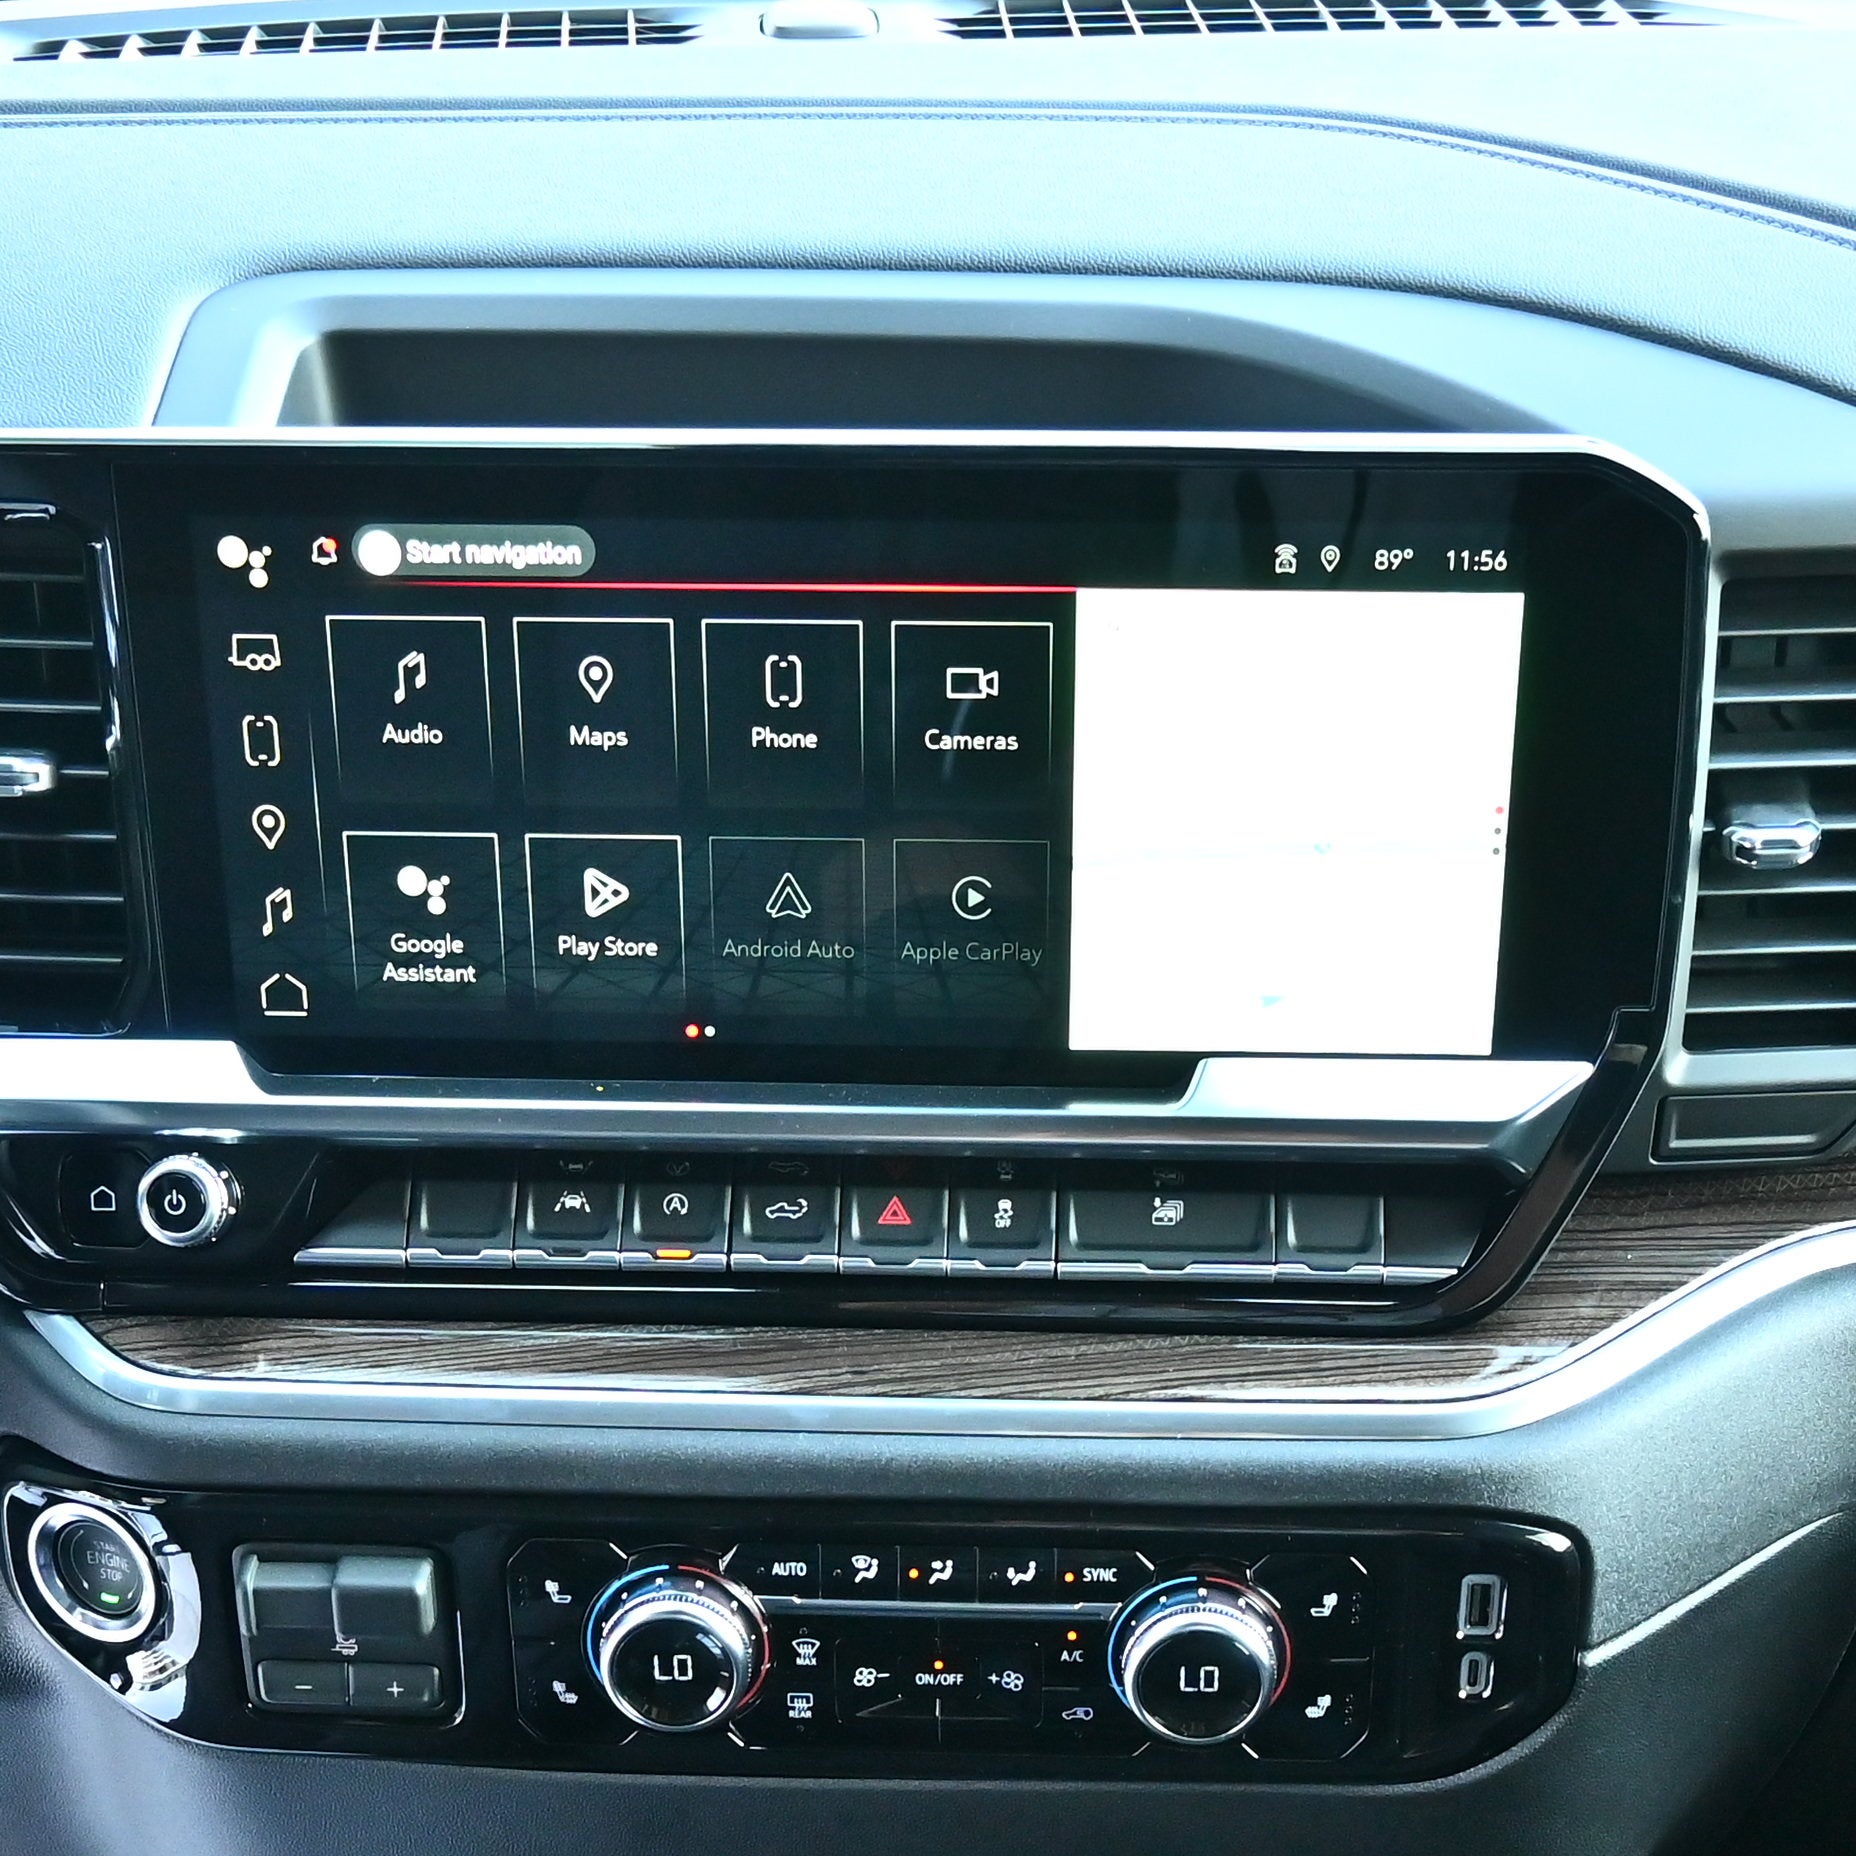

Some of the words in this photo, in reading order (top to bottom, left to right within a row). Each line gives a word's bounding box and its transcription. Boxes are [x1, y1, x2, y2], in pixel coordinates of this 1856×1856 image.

[406, 540, 461, 565] Start
[464, 539, 583, 569] navigation
[1446, 549, 1508, 572] 11:56
[381, 723, 444, 746] Audio
[569, 725, 629, 751] Maps
[751, 727, 818, 751] Phone
[924, 729, 1019, 752] Cameras
[390, 933, 465, 959] Google
[557, 935, 598, 962] Play
[603, 935, 659, 958] Store
[722, 938, 803, 961] Android
[809, 939, 856, 962] Auto
[901, 940, 957, 966] Apple
[959, 940, 1043, 968] CarPlay
[382, 961, 477, 984] Assistant
[995, 1218, 1011, 1228] OFF
[86, 1550, 130, 1573] ENGINE
[771, 1562, 807, 1578] AUTO
[100, 1567, 123, 1582] STOP
[1082, 1567, 1118, 1583] SYNC
[795, 1654, 817, 1666] MAX
[1060, 1648, 1085, 1663] A/C
[652, 1654, 693, 1682] LO
[915, 1672, 964, 1687] ON/OFF
[1179, 1665, 1220, 1693] LO
[788, 1706, 812, 1719] REAR
